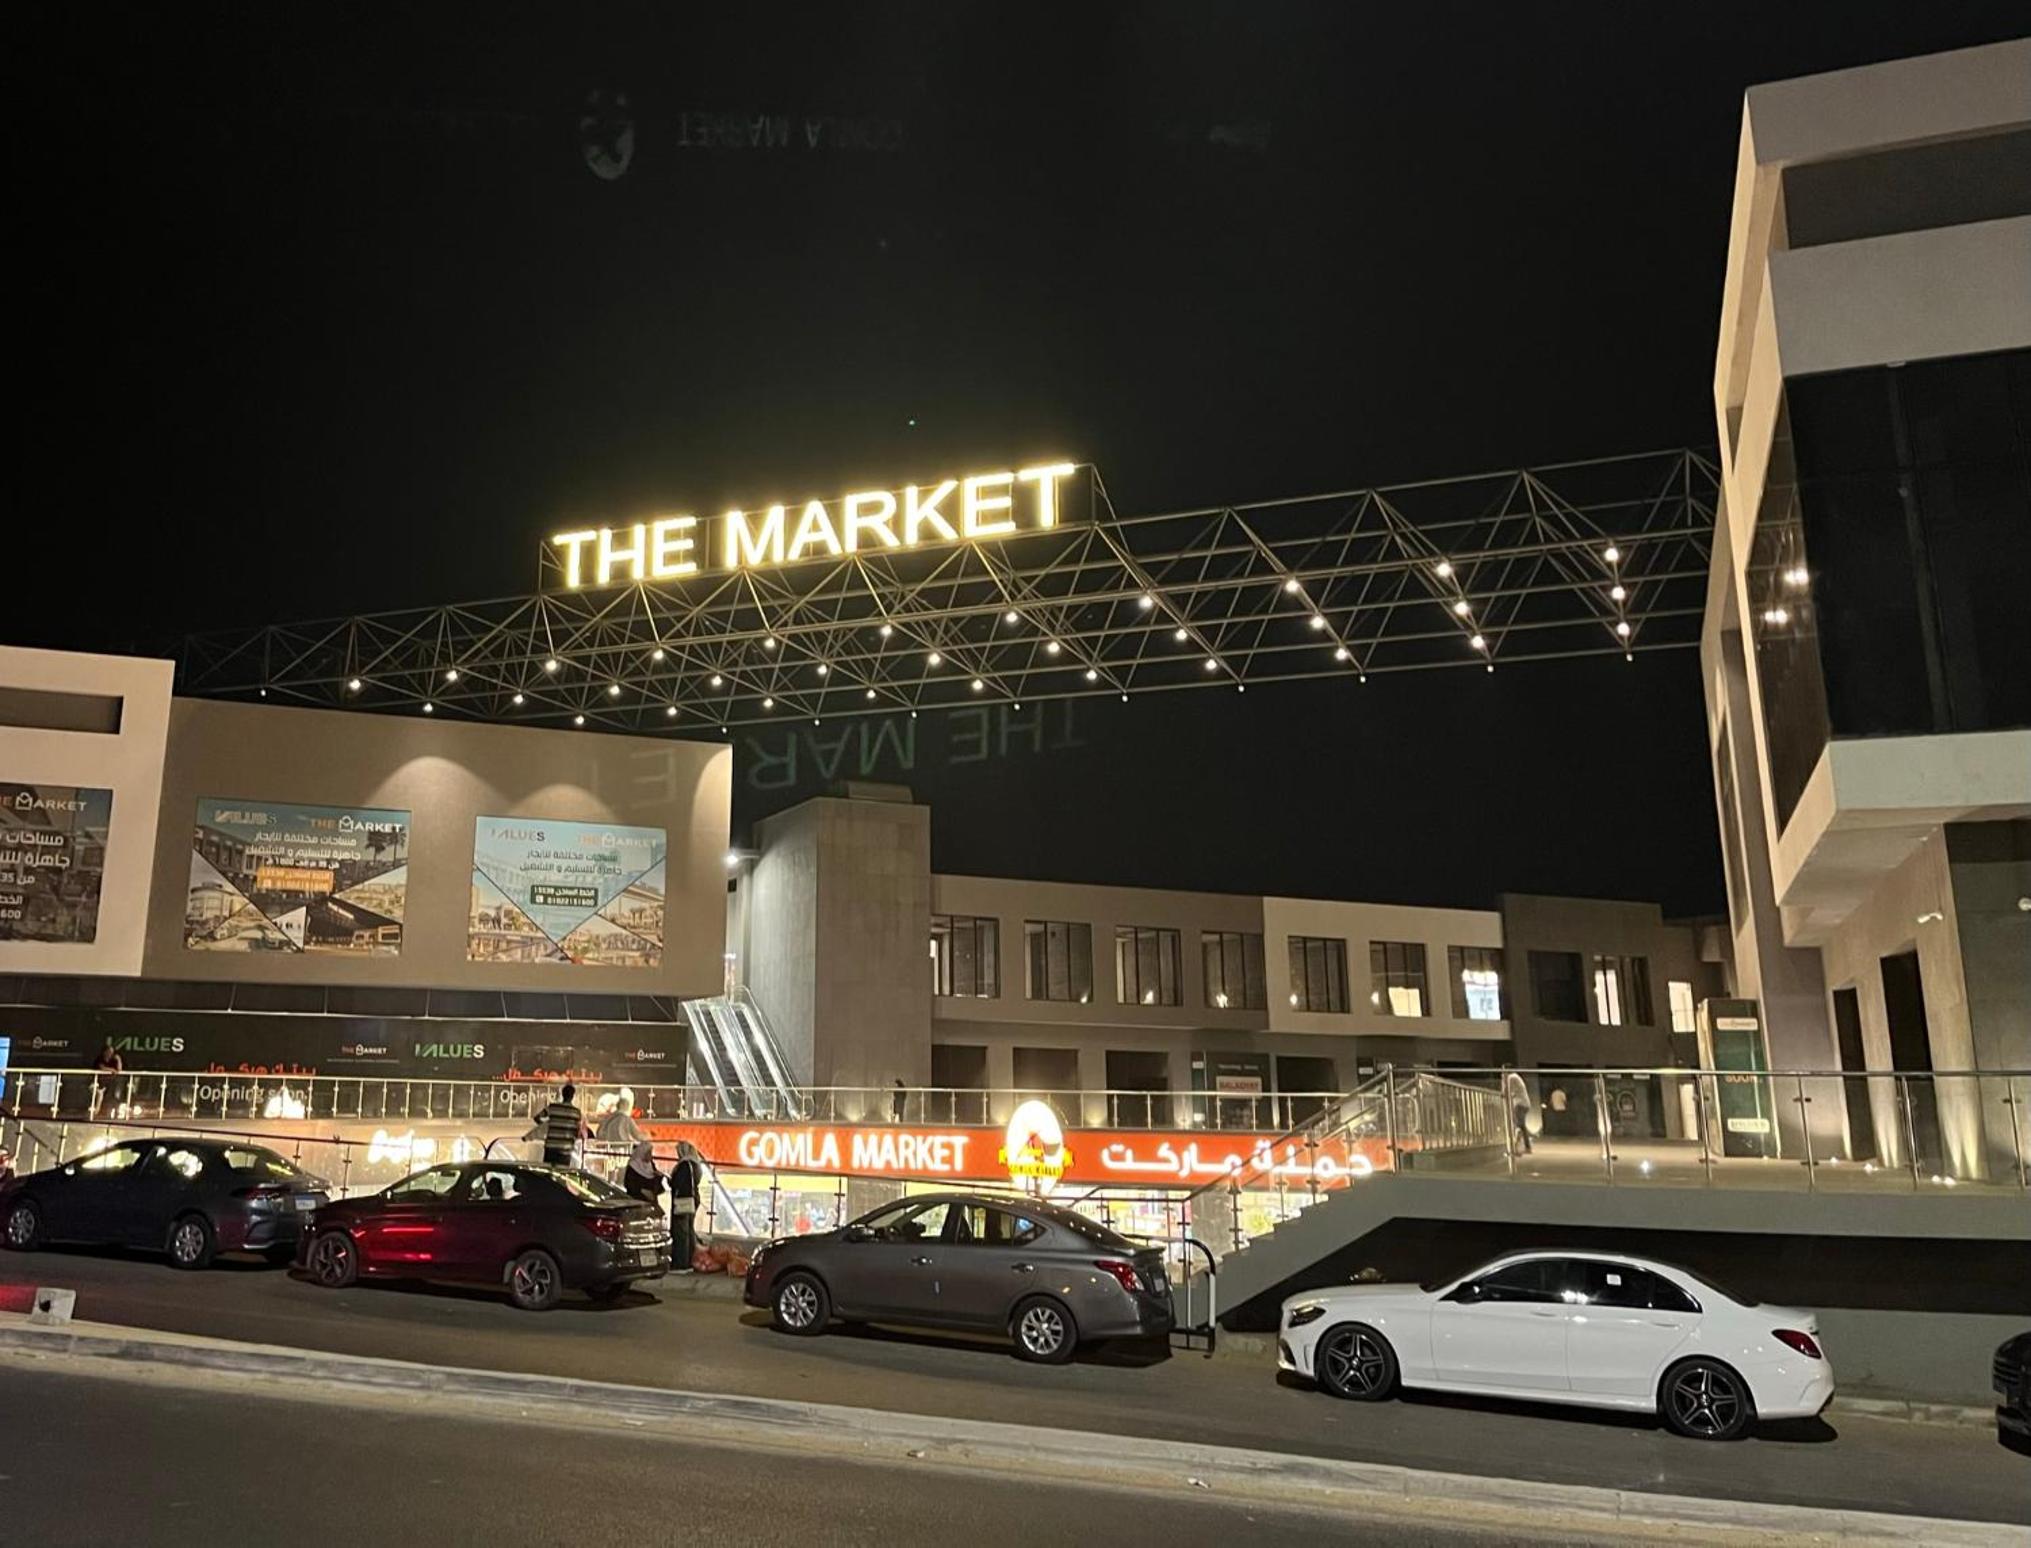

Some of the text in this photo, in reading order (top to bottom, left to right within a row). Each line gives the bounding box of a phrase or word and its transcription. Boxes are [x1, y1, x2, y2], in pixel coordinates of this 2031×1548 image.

[553, 463, 1075, 588] THE MARKET
[15, 792, 87, 812] MARKET
[339, 815, 404, 833] MARKET
[6, 831, 64, 846] مساحات
[25, 850, 70, 869] جاهزة
[106, 1036, 184, 1052] VALUES
[415, 1044, 485, 1059] VALUES
[199, 1085, 265, 1104] Opening
[738, 1131, 969, 1171] GOMLA MARKET
